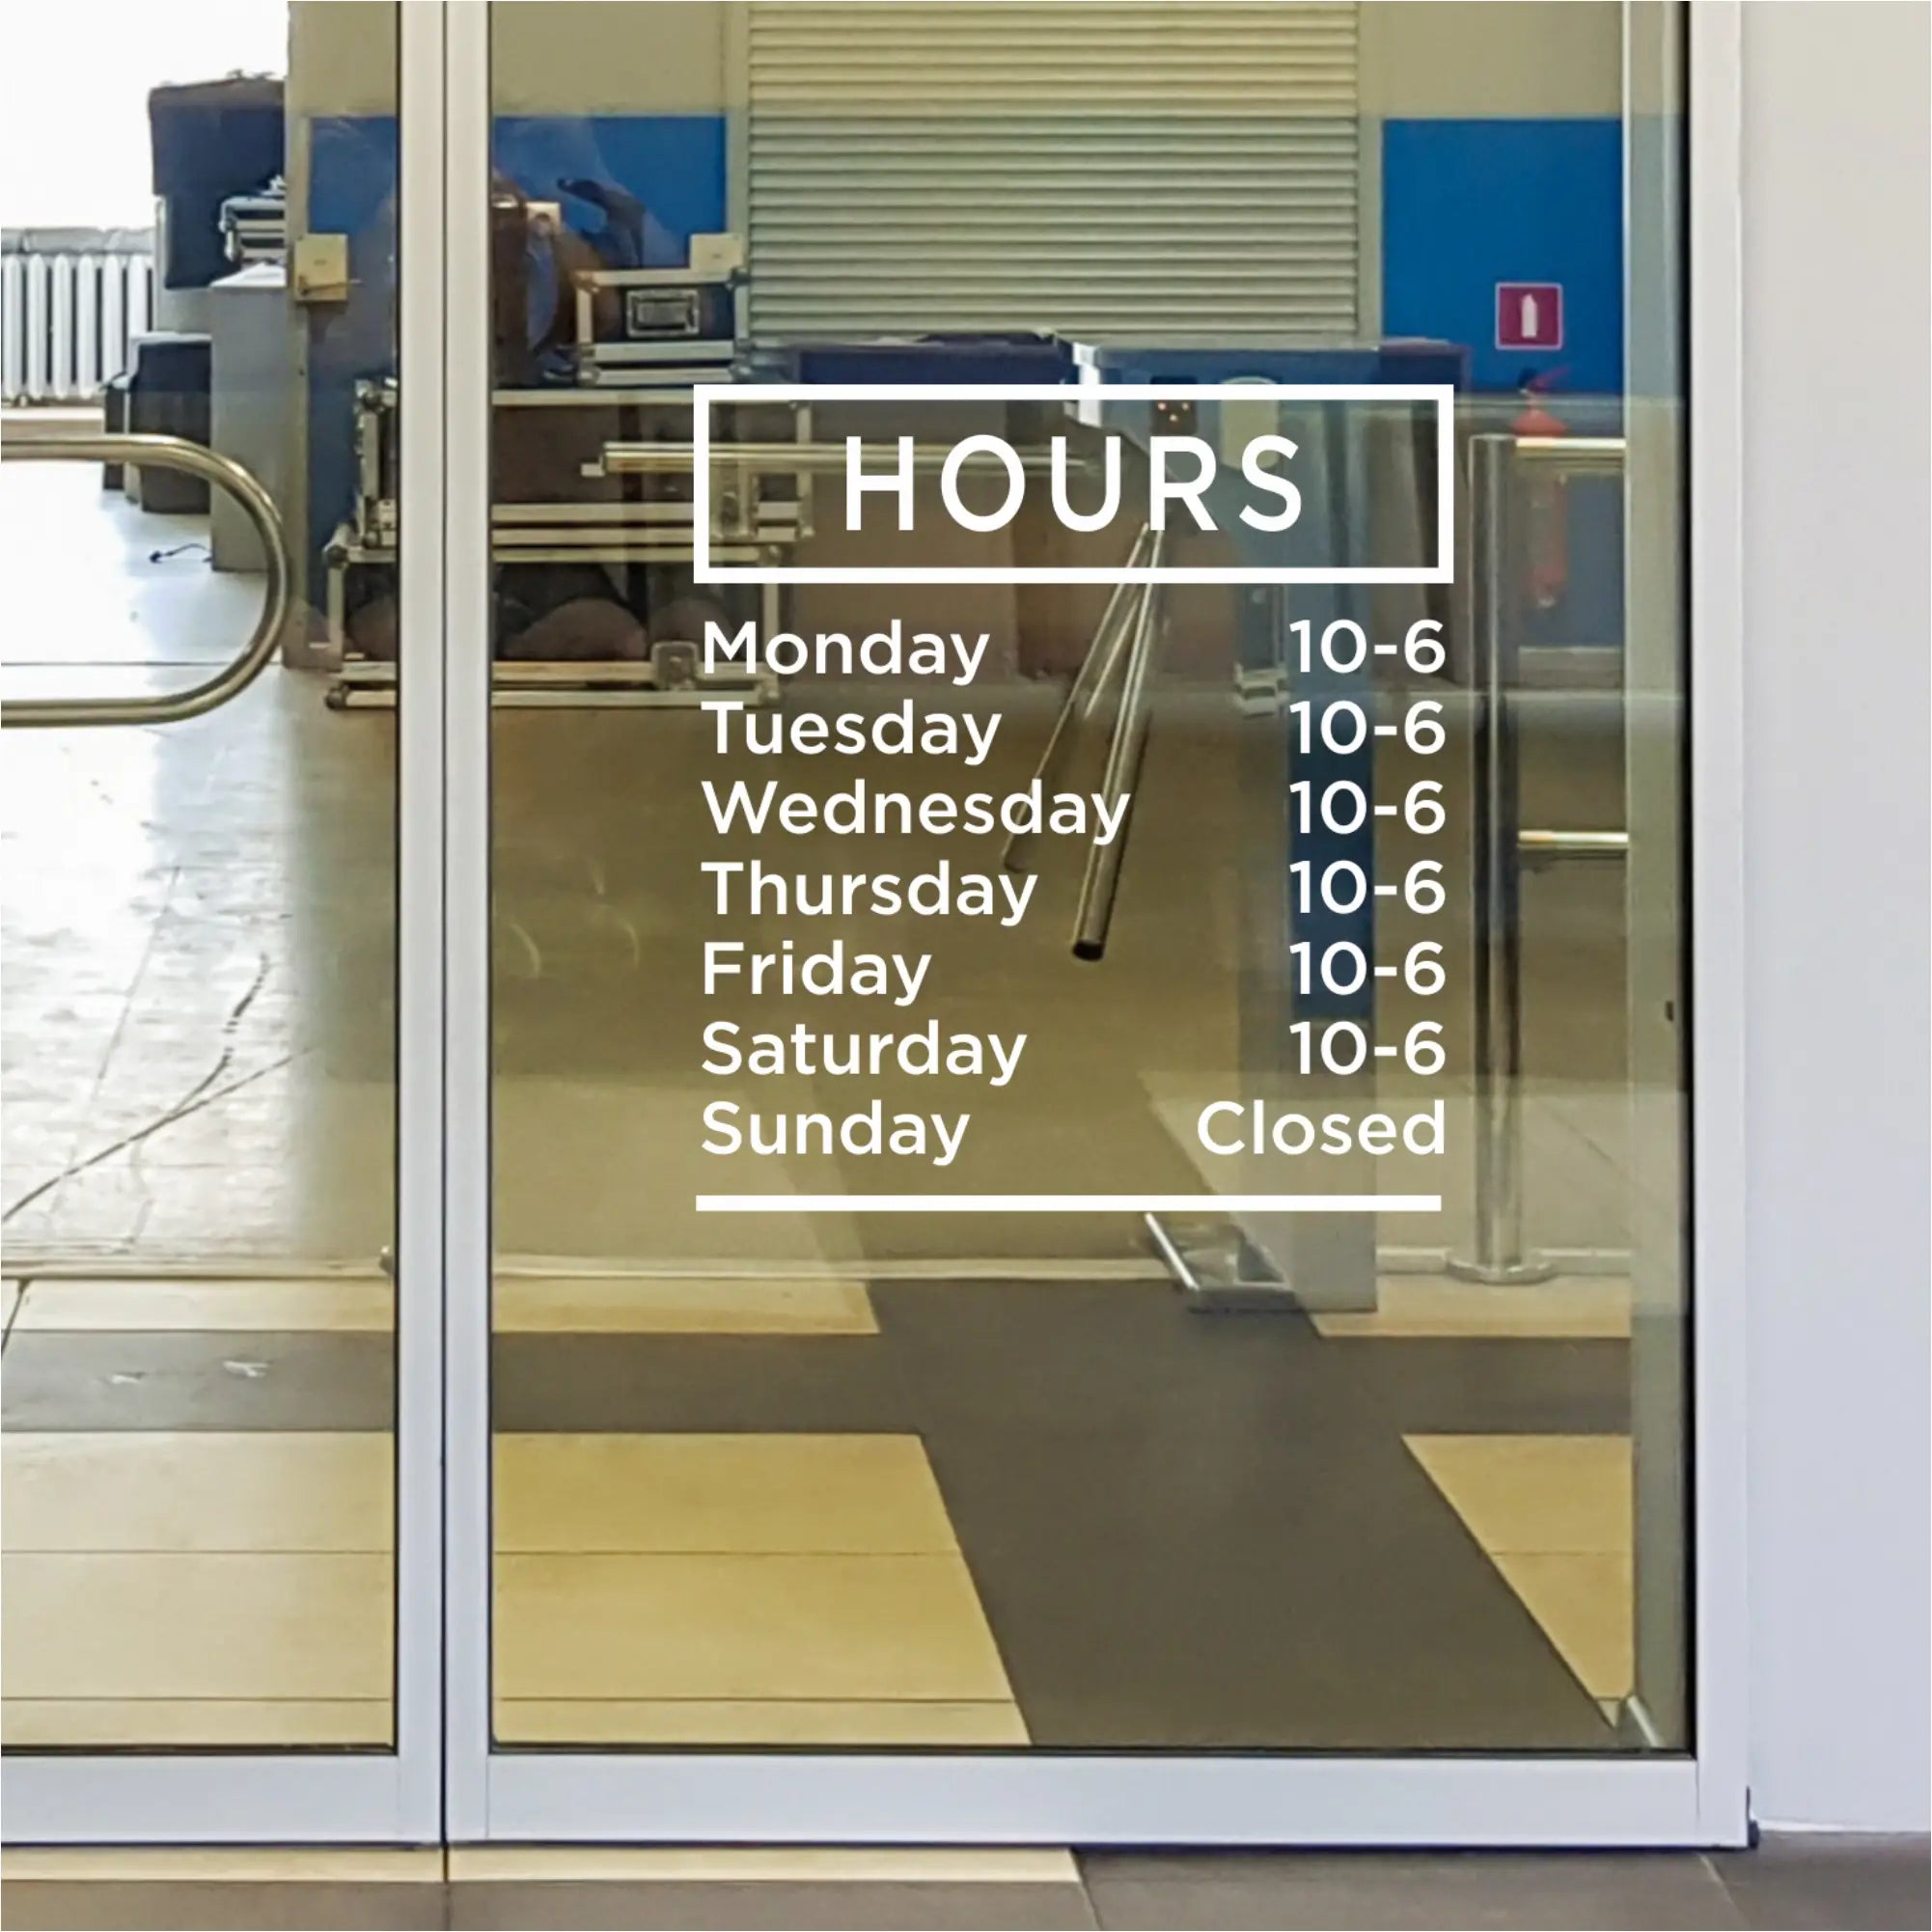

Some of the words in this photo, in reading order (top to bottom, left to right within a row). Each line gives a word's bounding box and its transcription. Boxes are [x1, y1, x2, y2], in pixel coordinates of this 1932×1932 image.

[845, 435, 1303, 533] HOURS
[703, 621, 990, 684] Monday
[1287, 620, 1446, 674] 10-6
[701, 701, 1001, 764] Tuesday
[1287, 701, 1446, 754] 10-6
[702, 780, 1130, 844] Wednesday
[1287, 781, 1446, 834] 10-6
[701, 860, 1037, 925] Thursday
[1287, 861, 1446, 915] 10-6
[703, 940, 932, 1005] Friday
[1287, 941, 1446, 995] 10-6
[700, 1021, 1027, 1085] Saturday
[1287, 1021, 1446, 1075] 10-6
[700, 1101, 971, 1165] Sunday
[1197, 1100, 1446, 1155] Closed
